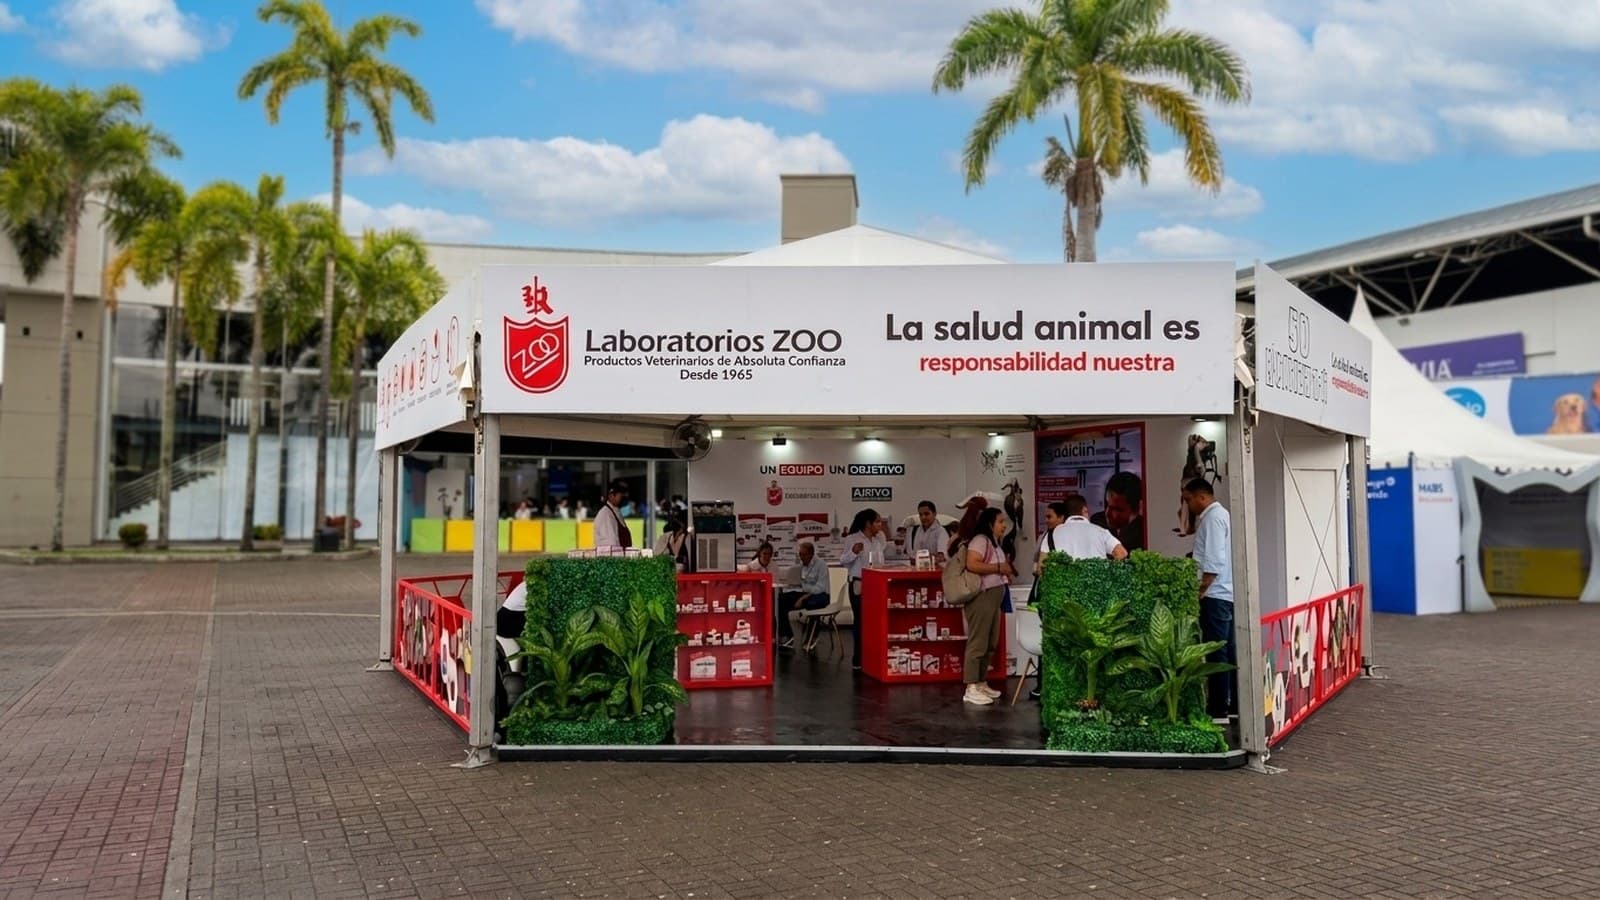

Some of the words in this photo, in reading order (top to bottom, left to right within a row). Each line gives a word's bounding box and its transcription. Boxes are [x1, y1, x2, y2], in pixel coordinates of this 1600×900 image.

[886, 313, 923, 341] La
[934, 309, 1023, 341] salud
[1034, 309, 1152, 341] animal
[1163, 319, 1200, 341] es
[585, 328, 765, 353] Laboratorios
[771, 329, 842, 353] ZOO
[584, 355, 643, 367] Productos
[644, 355, 715, 367] Veterinarios
[716, 355, 732, 367] de
[733, 355, 786, 367] Absoluta
[788, 355, 846, 367] Confianza
[919, 351, 1087, 376] responsabilidad
[1093, 353, 1175, 372] nuestra
[680, 368, 719, 381] Desde
[722, 368, 753, 381] 1965
[760, 464, 776, 474] UN
[780, 465, 823, 475] EQUIPO
[829, 465, 846, 474] UN
[850, 464, 903, 475] OBJETIVO
